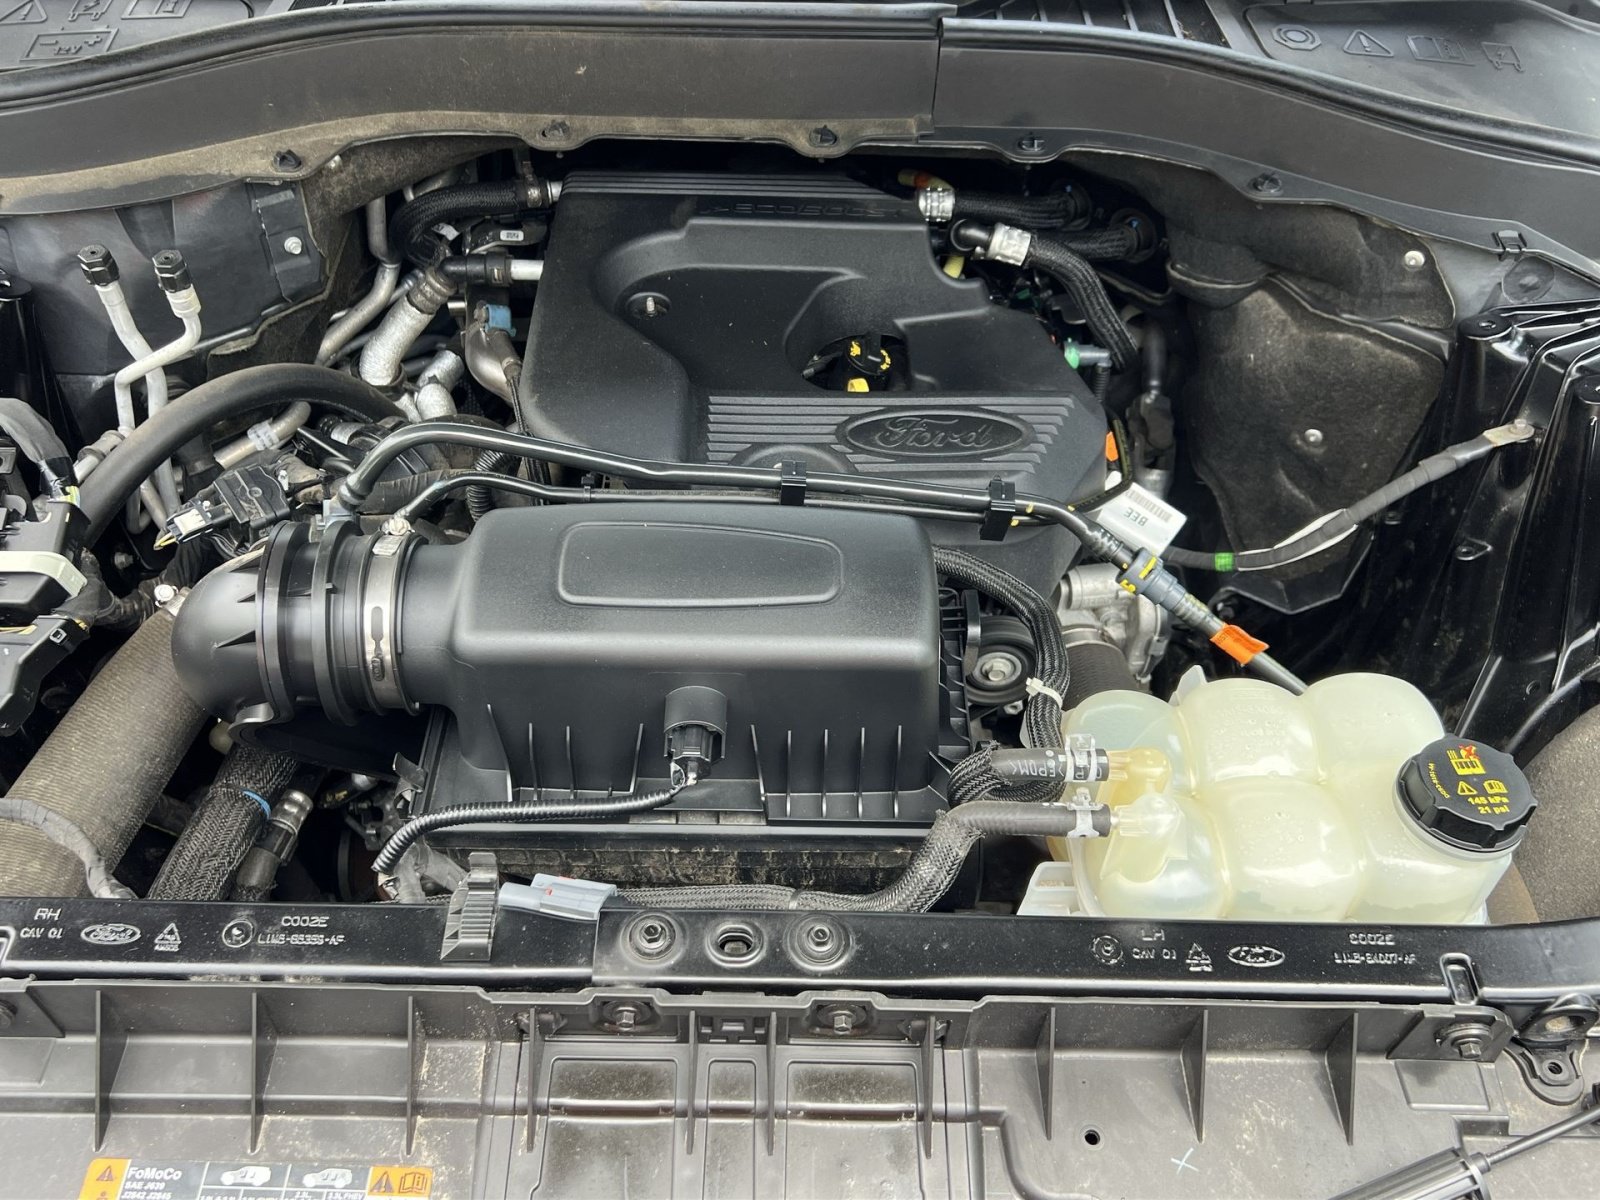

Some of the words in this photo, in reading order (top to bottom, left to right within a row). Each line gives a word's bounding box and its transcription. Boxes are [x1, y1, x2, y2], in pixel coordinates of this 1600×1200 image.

[874, 417, 994, 448] Ford
[1124, 507, 1149, 527] BEE
[1478, 806, 1492, 814] 21
[34, 908, 62, 921] RH
[20, 927, 43, 939] CAV
[86, 925, 137, 942] Ford
[1141, 928, 1166, 941] LH
[127, 1166, 182, 1181] FoMoCo
[125, 1181, 144, 1190] SAE
[144, 1181, 166, 1191] J639
